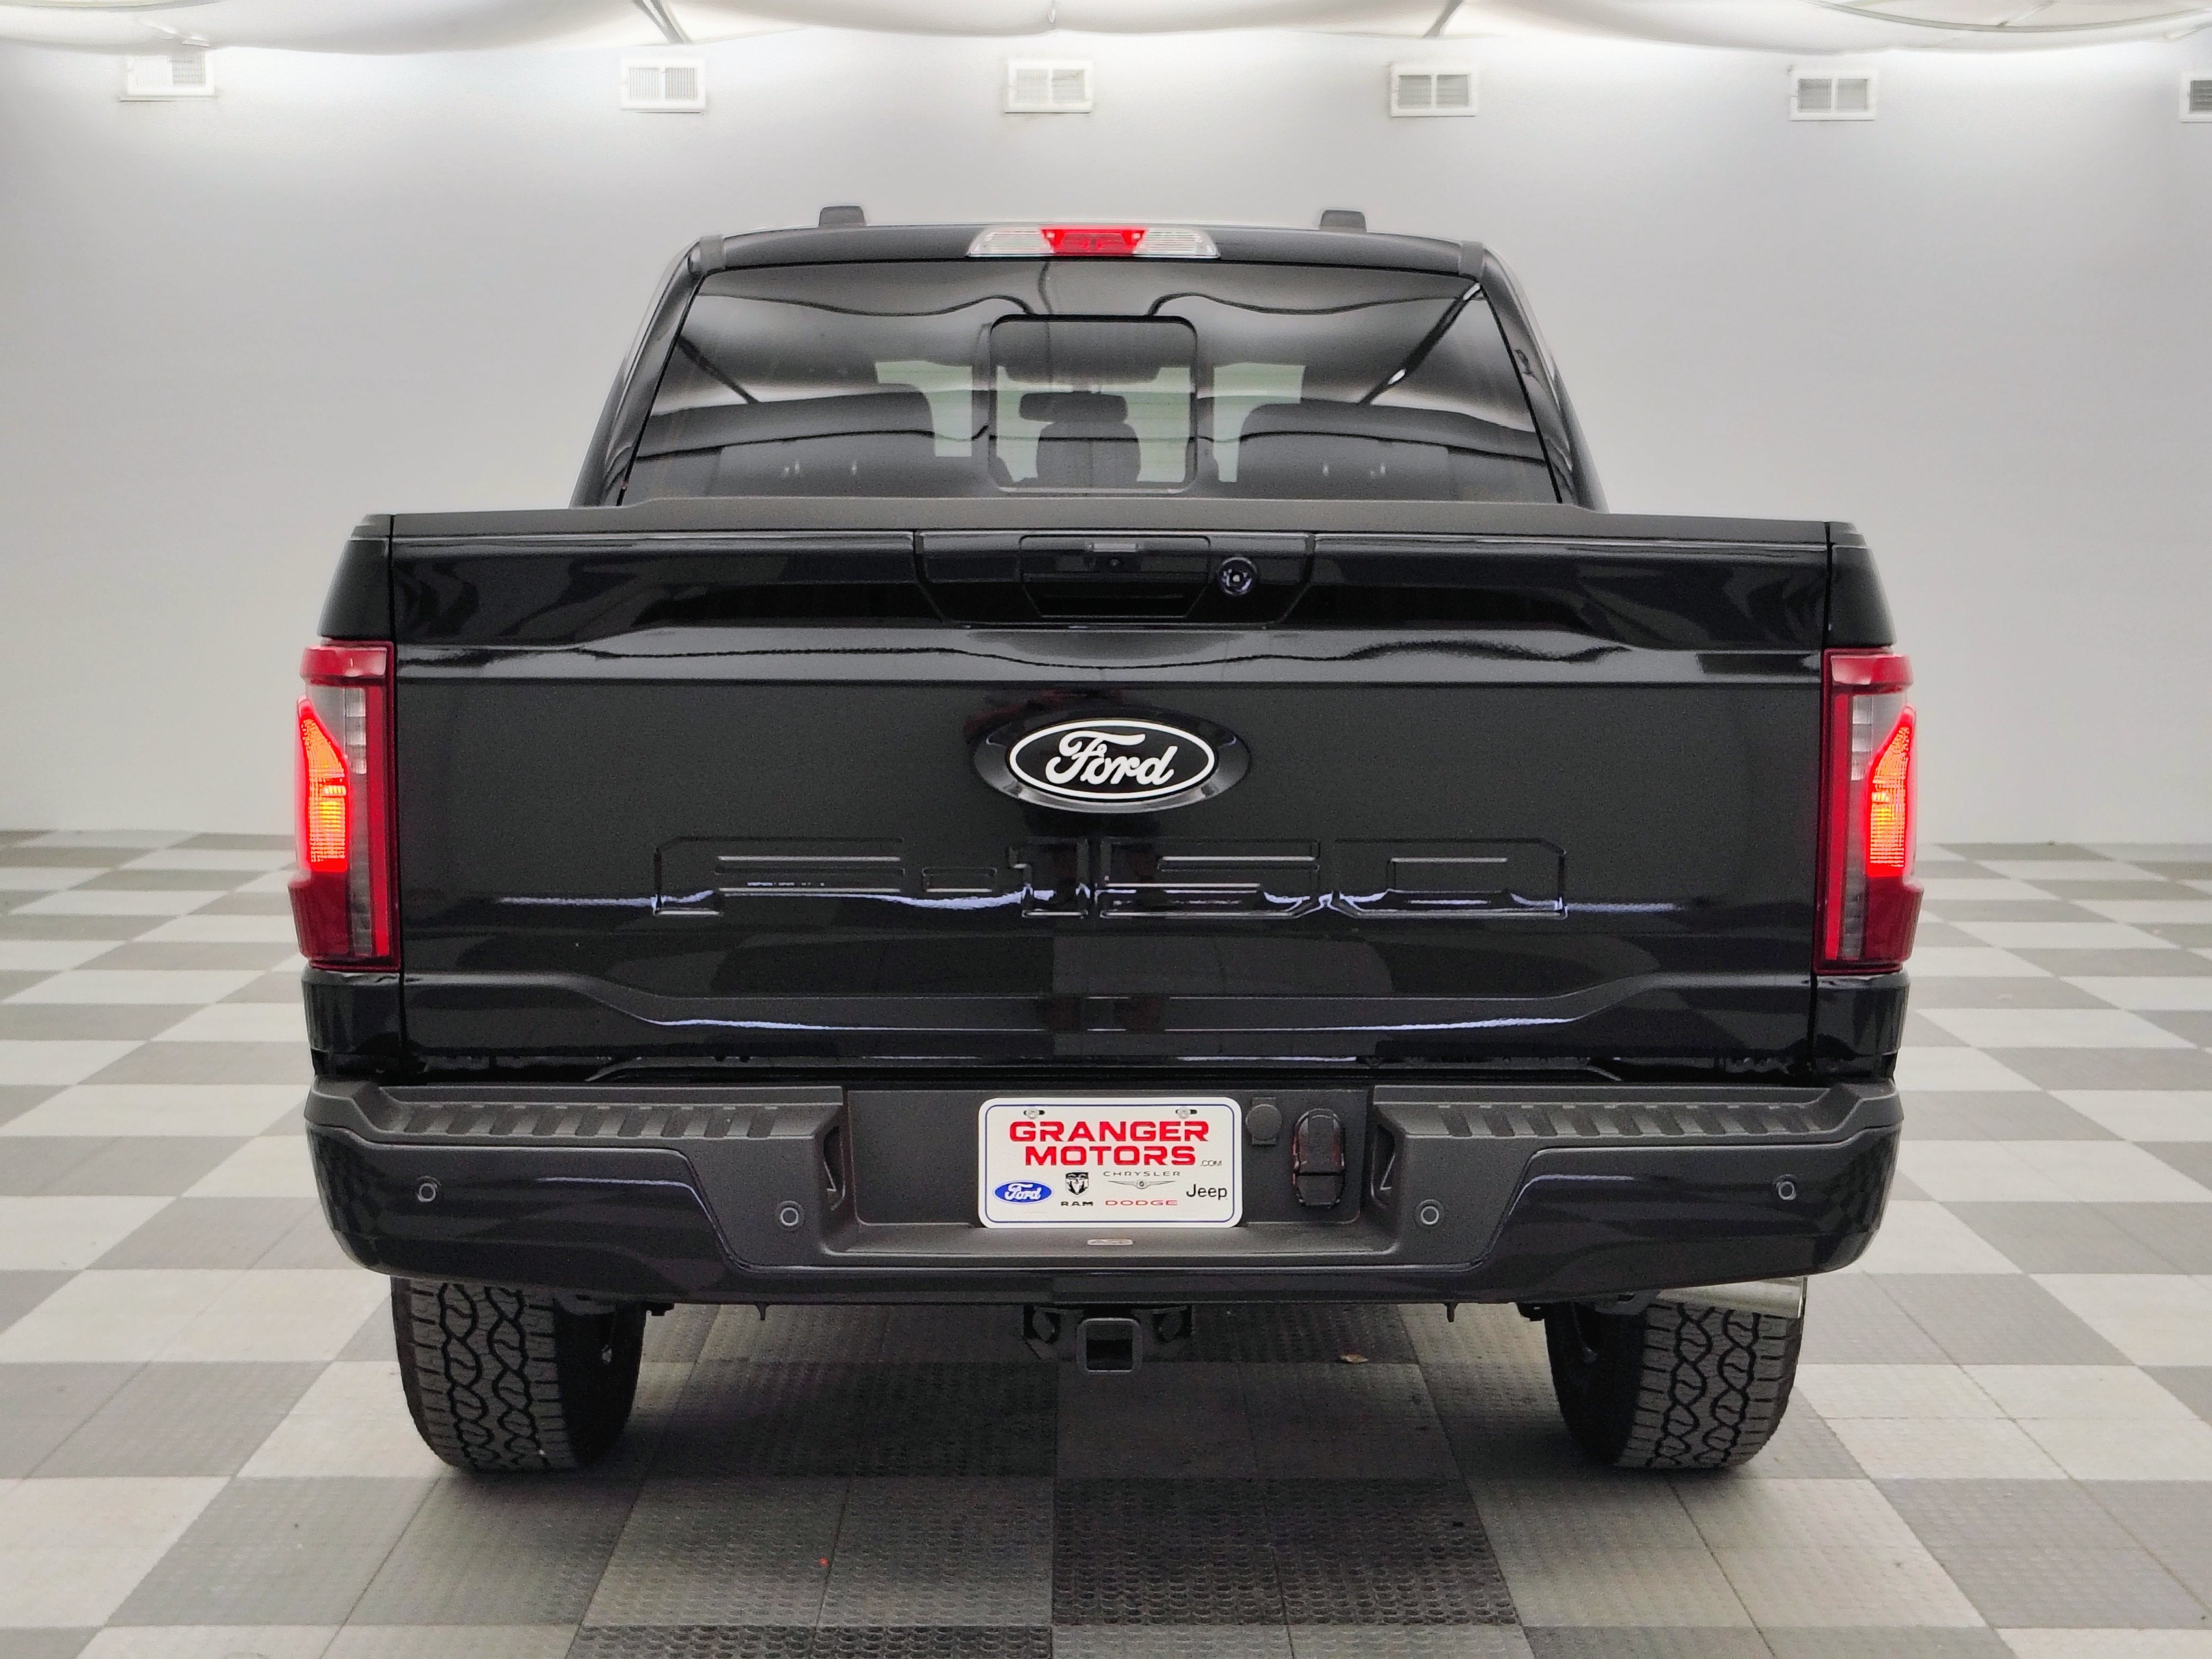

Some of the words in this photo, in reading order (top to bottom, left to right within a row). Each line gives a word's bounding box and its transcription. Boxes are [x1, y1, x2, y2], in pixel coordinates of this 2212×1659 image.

[1046, 731, 1178, 785] Ford
[652, 837, 1567, 917] F-150
[1009, 1122, 1209, 1142] GRANGER
[1026, 1146, 1196, 1166] MOTORS
[1004, 1183, 1041, 1200] Ford
[1186, 1184, 1228, 1201] Jeep
